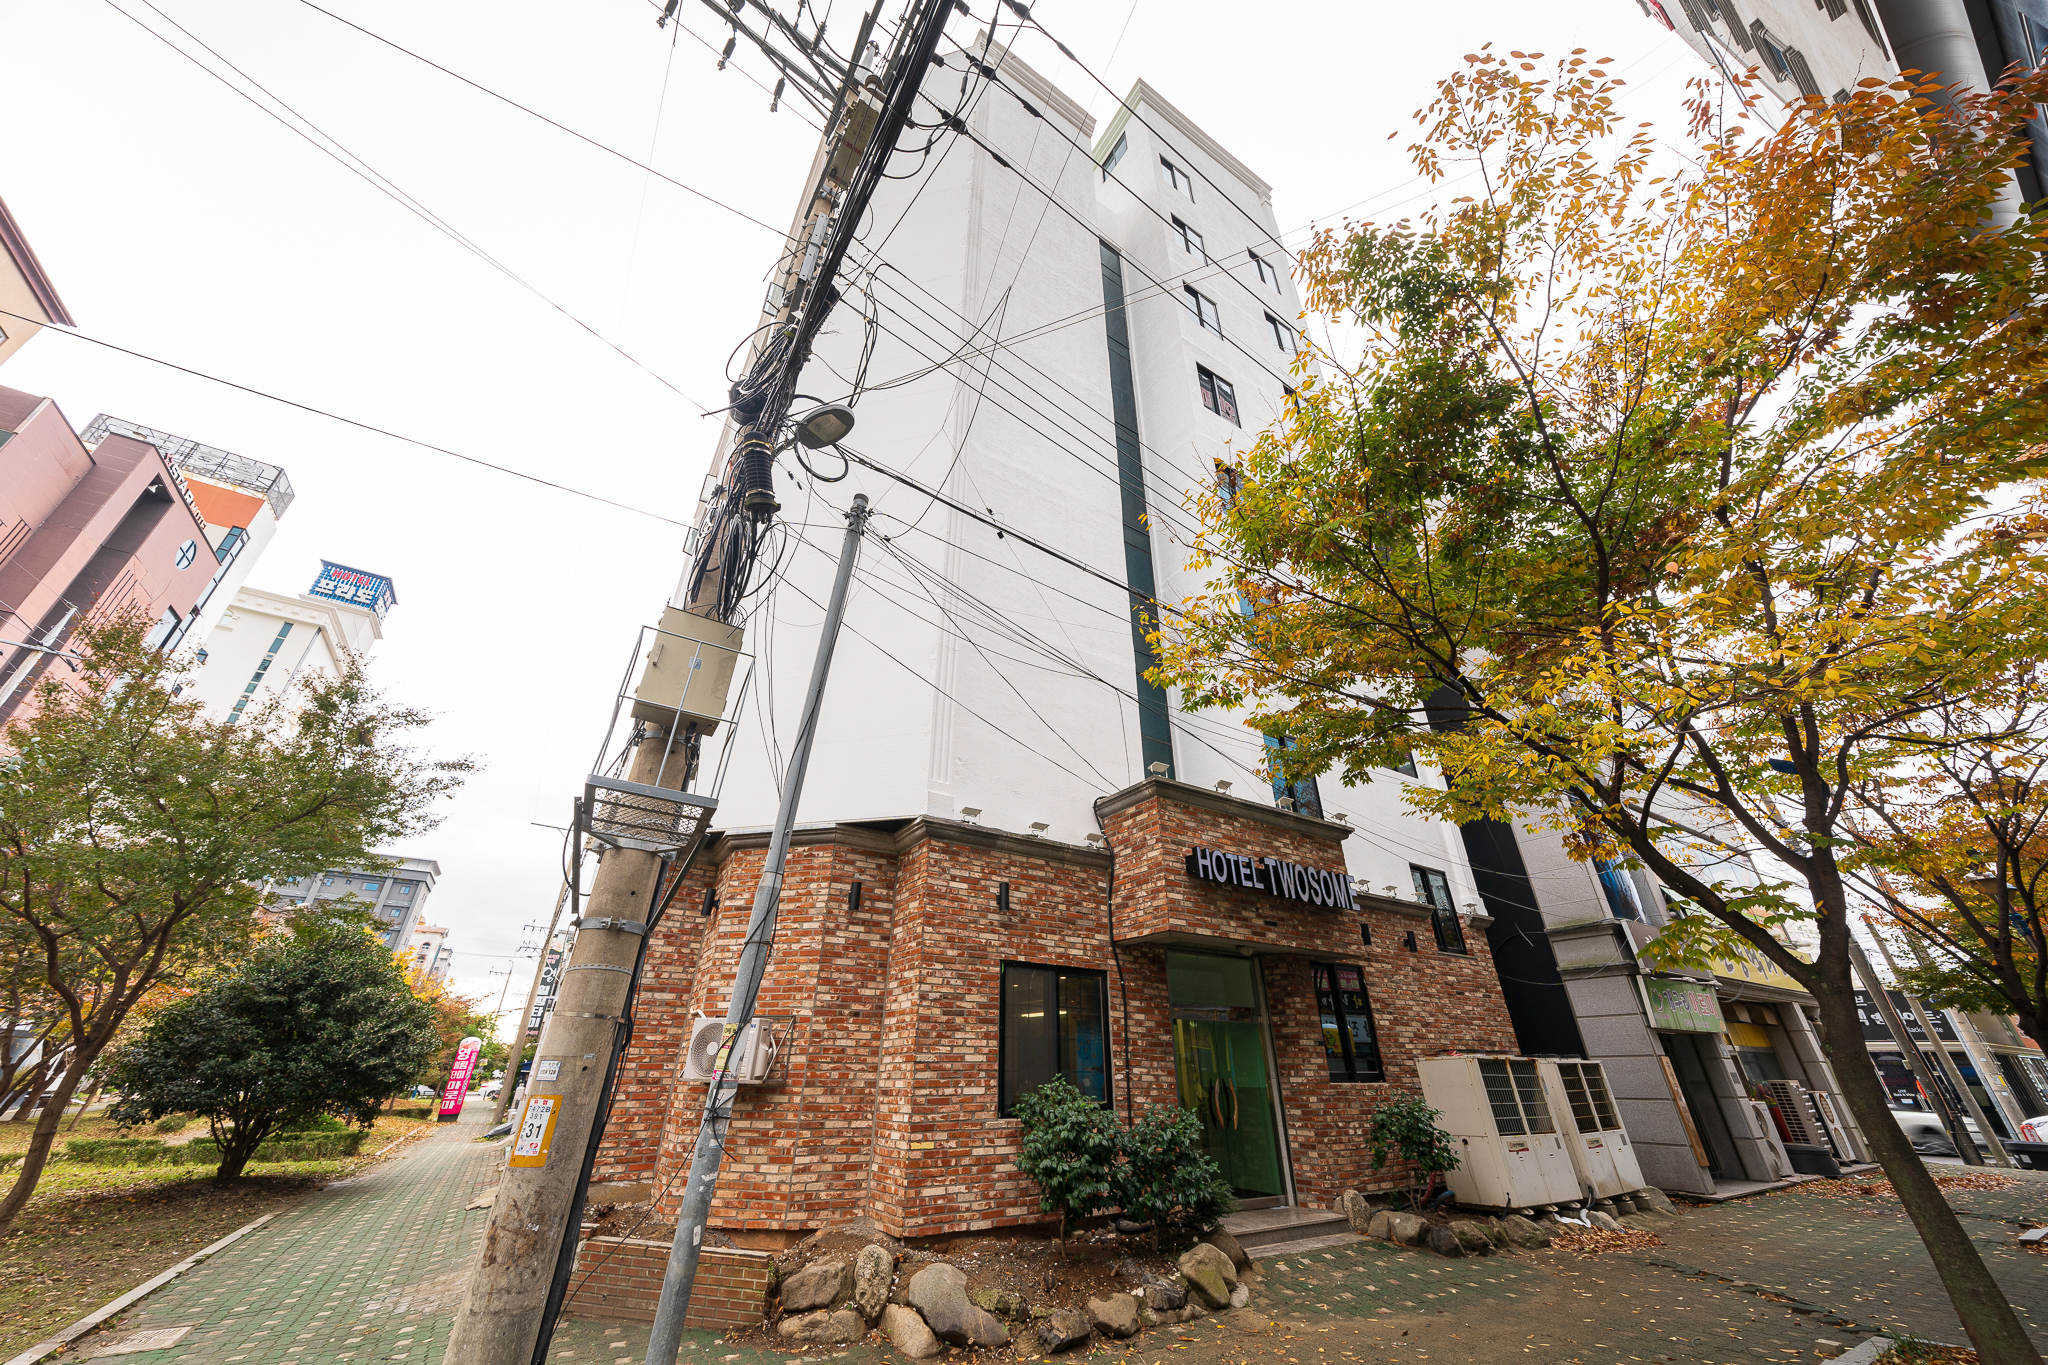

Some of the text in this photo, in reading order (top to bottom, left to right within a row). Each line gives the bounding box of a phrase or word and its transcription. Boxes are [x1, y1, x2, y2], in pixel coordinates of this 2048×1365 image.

[169, 464, 195, 506] STAR
[332, 569, 371, 587] HOTEL
[1196, 846, 1361, 911] HOTEL TWOSOME
[528, 1105, 551, 1114] 7472B
[529, 1112, 543, 1120] 391
[525, 1122, 543, 1139] 31
